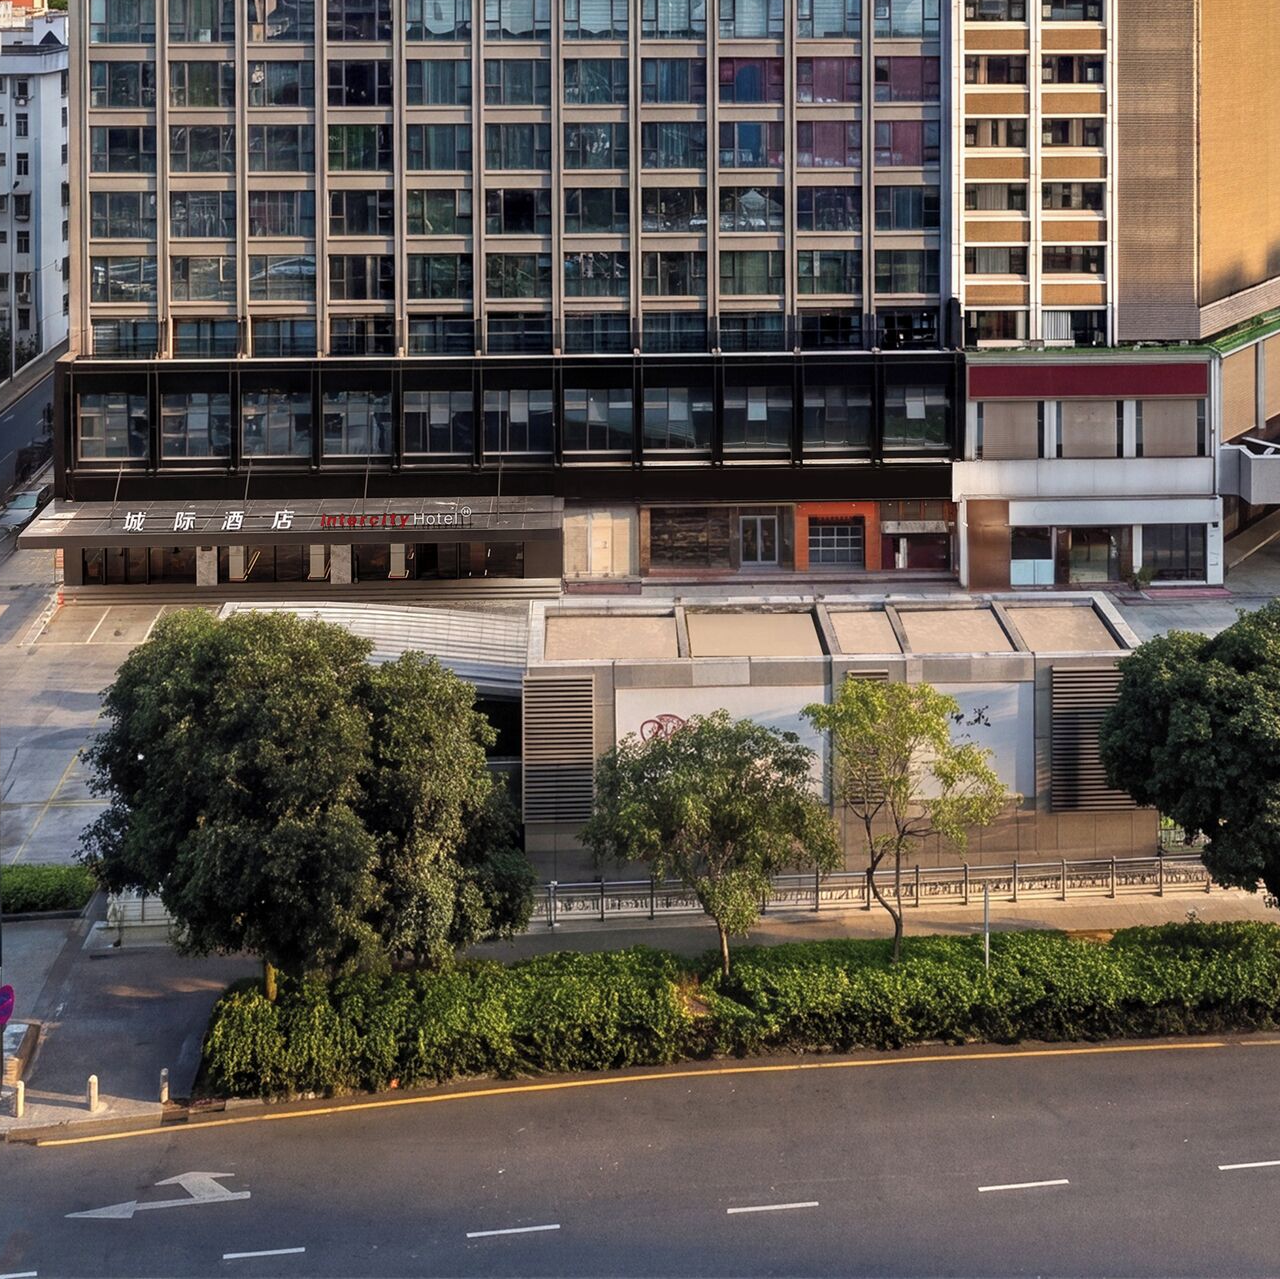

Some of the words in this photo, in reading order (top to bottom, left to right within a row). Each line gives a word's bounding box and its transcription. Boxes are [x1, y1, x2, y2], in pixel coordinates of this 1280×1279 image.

[122, 509, 295, 532] 城际酒店
[320, 512, 410, 528] Intercity
[413, 512, 459, 526] Hotel
